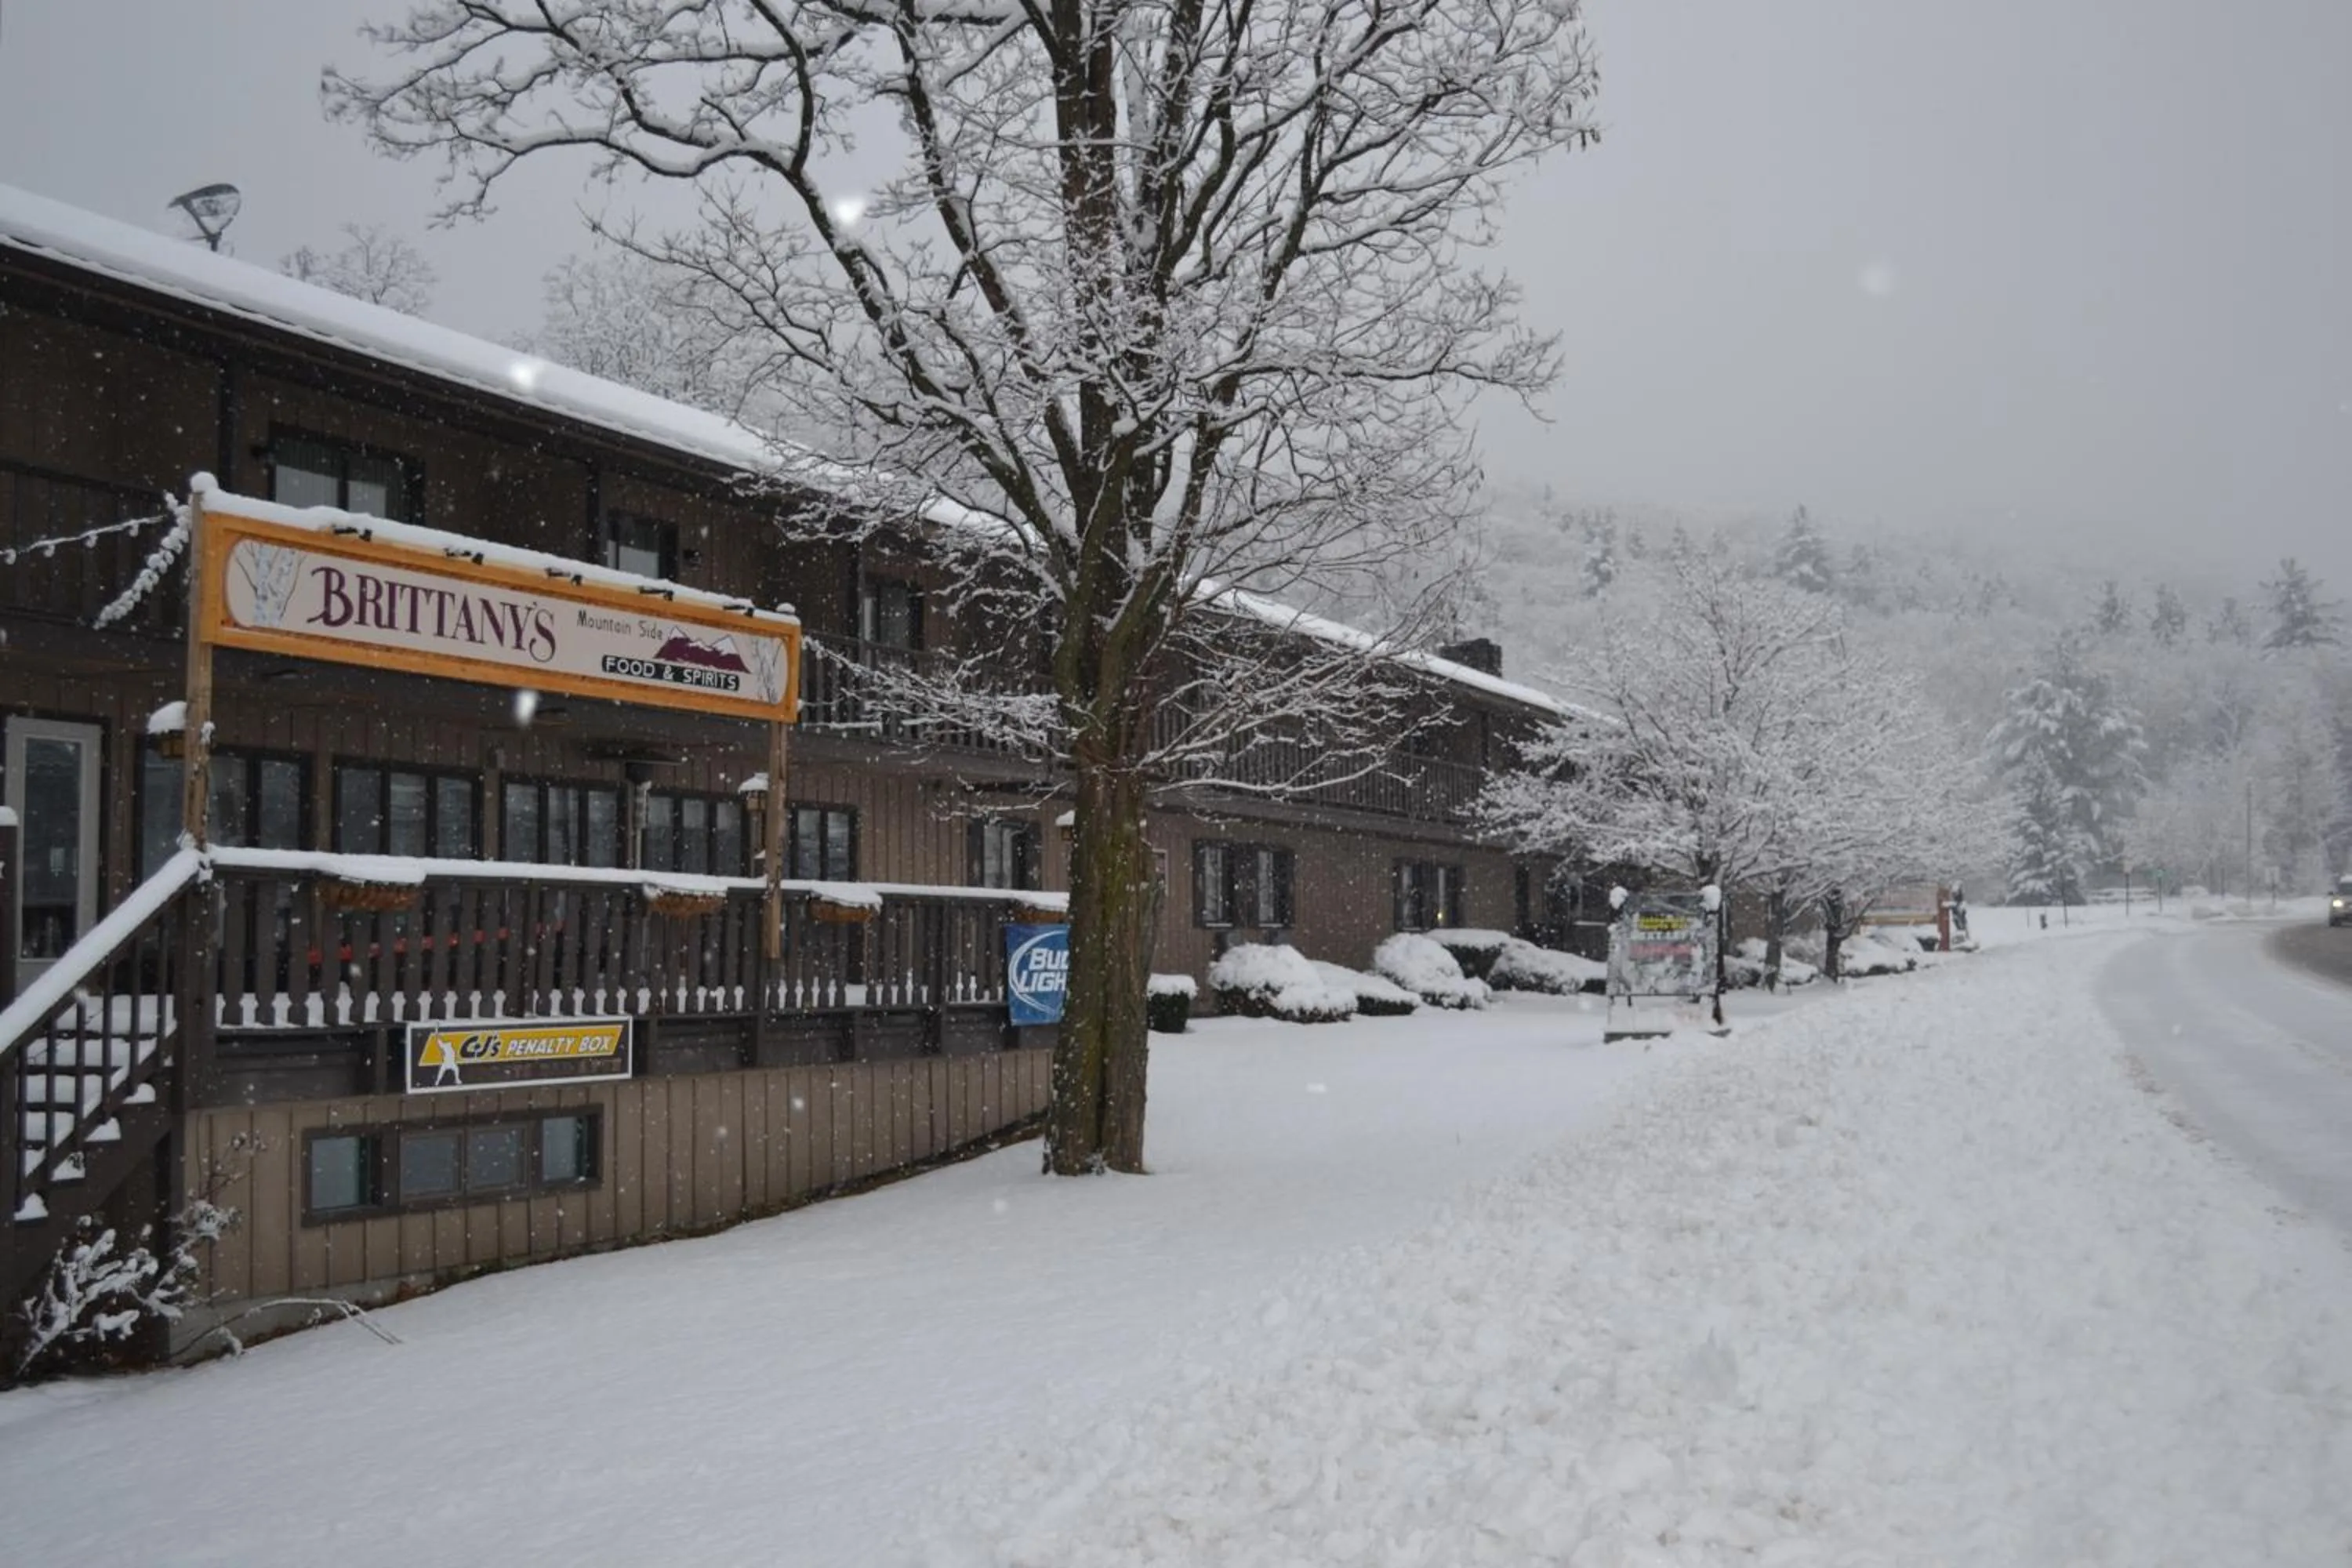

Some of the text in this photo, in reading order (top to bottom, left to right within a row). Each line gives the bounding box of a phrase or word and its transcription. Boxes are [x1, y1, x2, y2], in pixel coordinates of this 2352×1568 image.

[307, 566, 556, 662] BRITTANY'S
[576, 609, 663, 641] Mountain Side
[604, 656, 737, 690] FOOD & SPIRITS
[1019, 971, 1067, 992] LIGH
[506, 1037, 574, 1055] PENALTY
[579, 1035, 612, 1052] BOX
